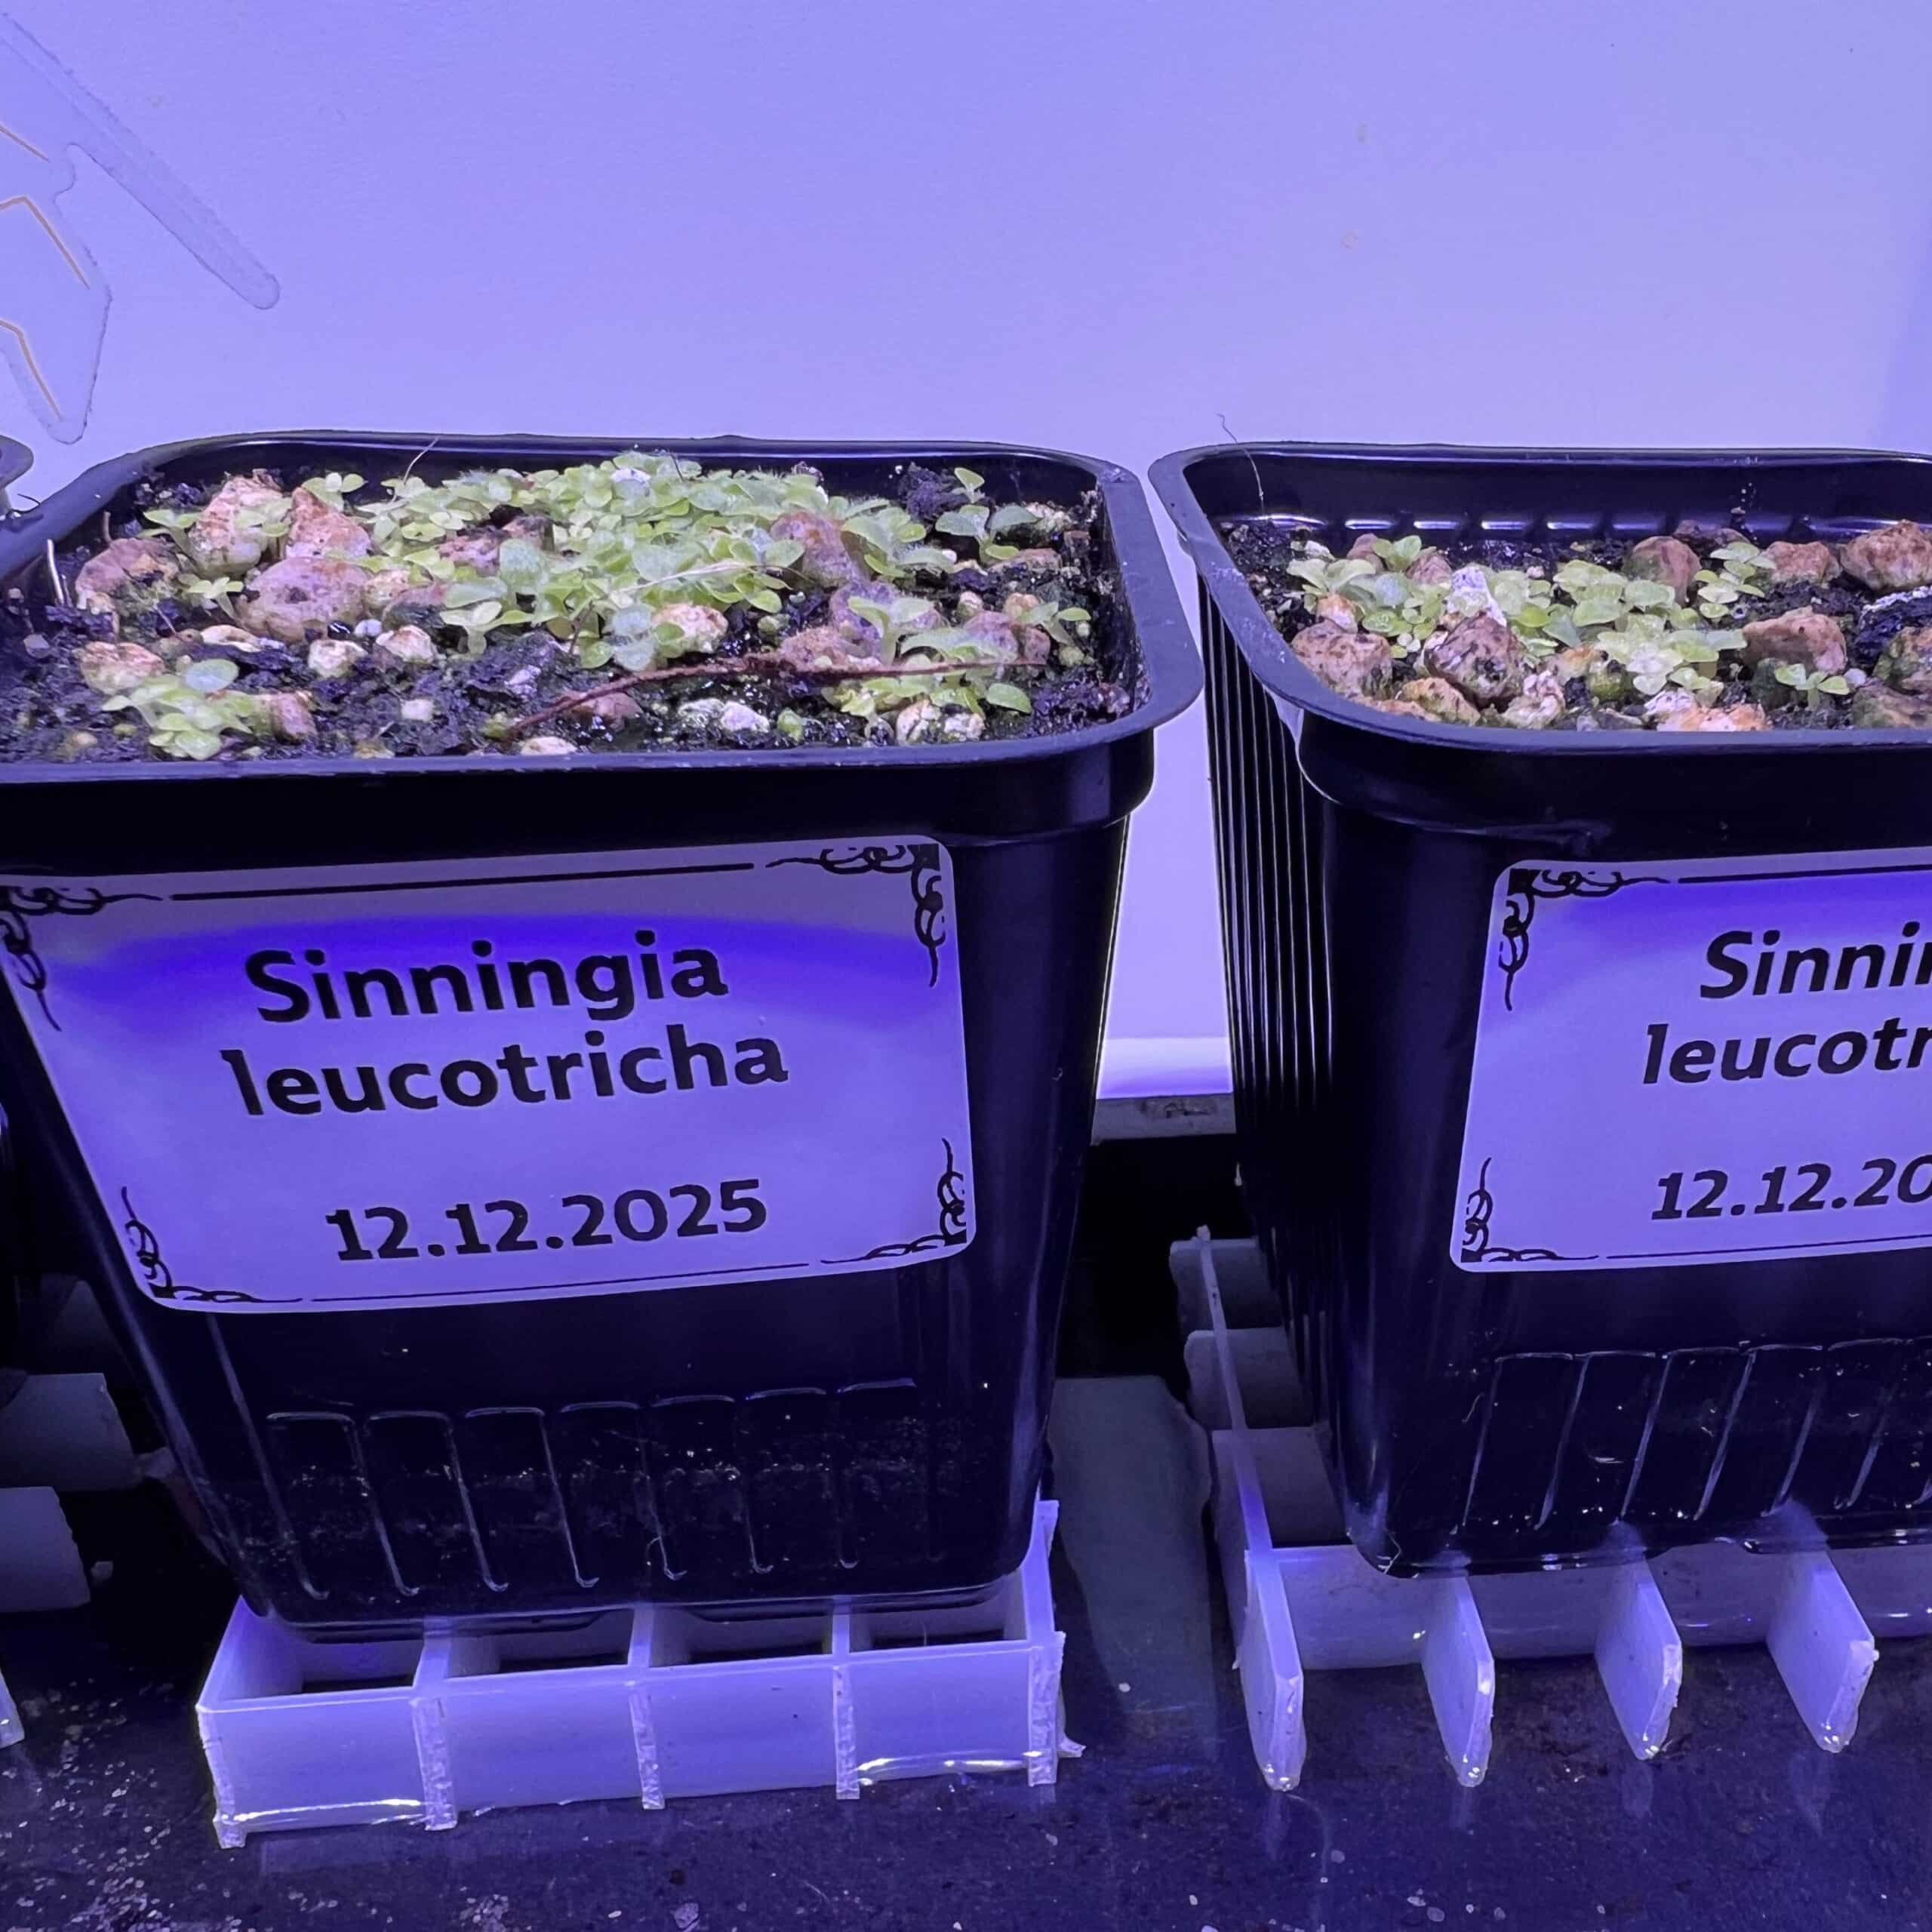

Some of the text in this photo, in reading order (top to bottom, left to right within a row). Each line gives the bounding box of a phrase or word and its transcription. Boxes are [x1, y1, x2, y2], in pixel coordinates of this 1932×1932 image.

[245, 929, 729, 1023] Sinningia
[220, 1023, 789, 1116] leucotricha
[326, 1179, 768, 1261] 12.12.2025
